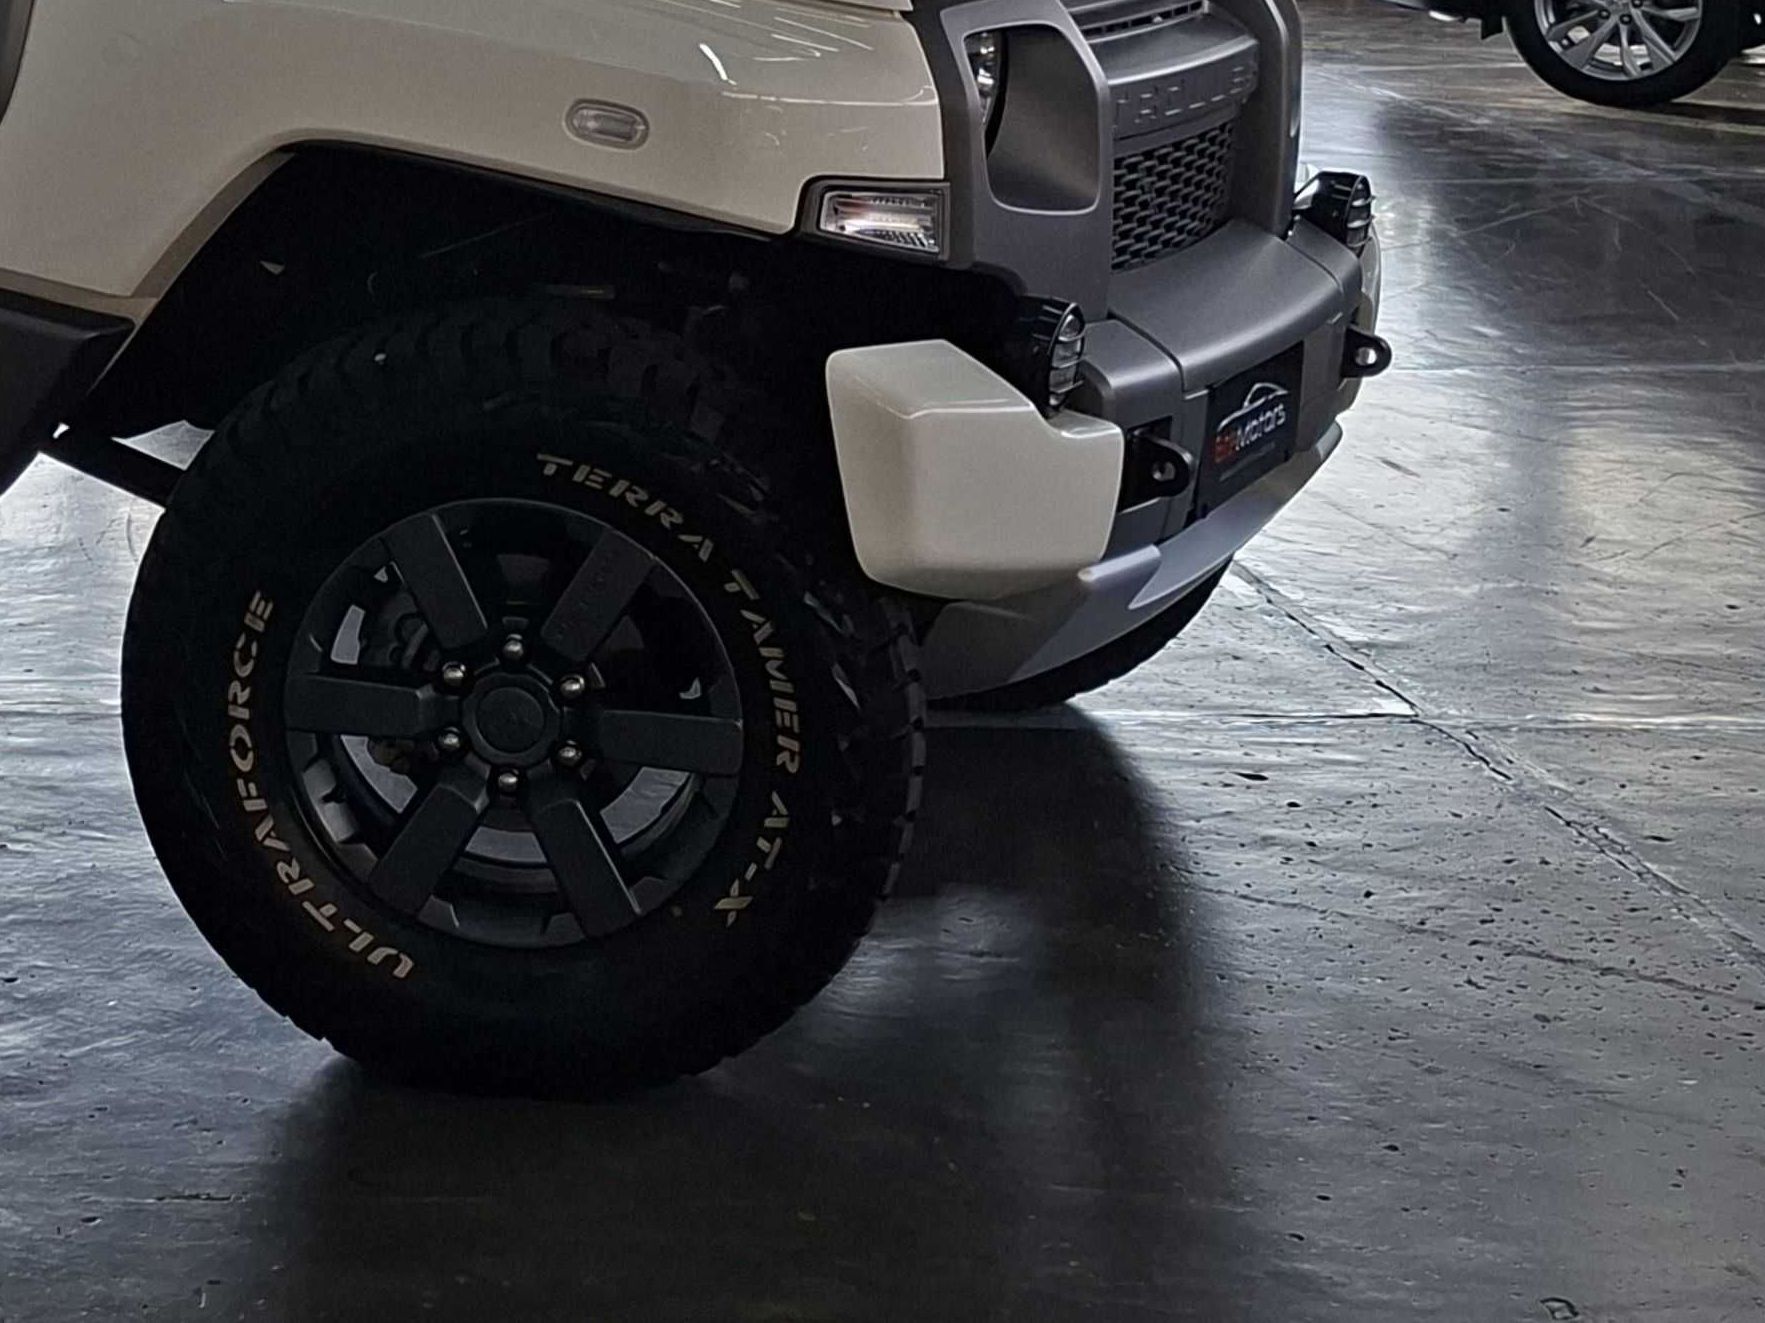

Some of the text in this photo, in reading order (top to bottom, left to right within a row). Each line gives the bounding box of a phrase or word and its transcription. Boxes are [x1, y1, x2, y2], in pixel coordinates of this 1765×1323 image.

[1235, 402, 1286, 451] Motors
[536, 452, 715, 563] TERRA
[723, 569, 801, 775] TAMER
[227, 589, 414, 978] ULTRAFORCE
[714, 790, 790, 928] AT-X
